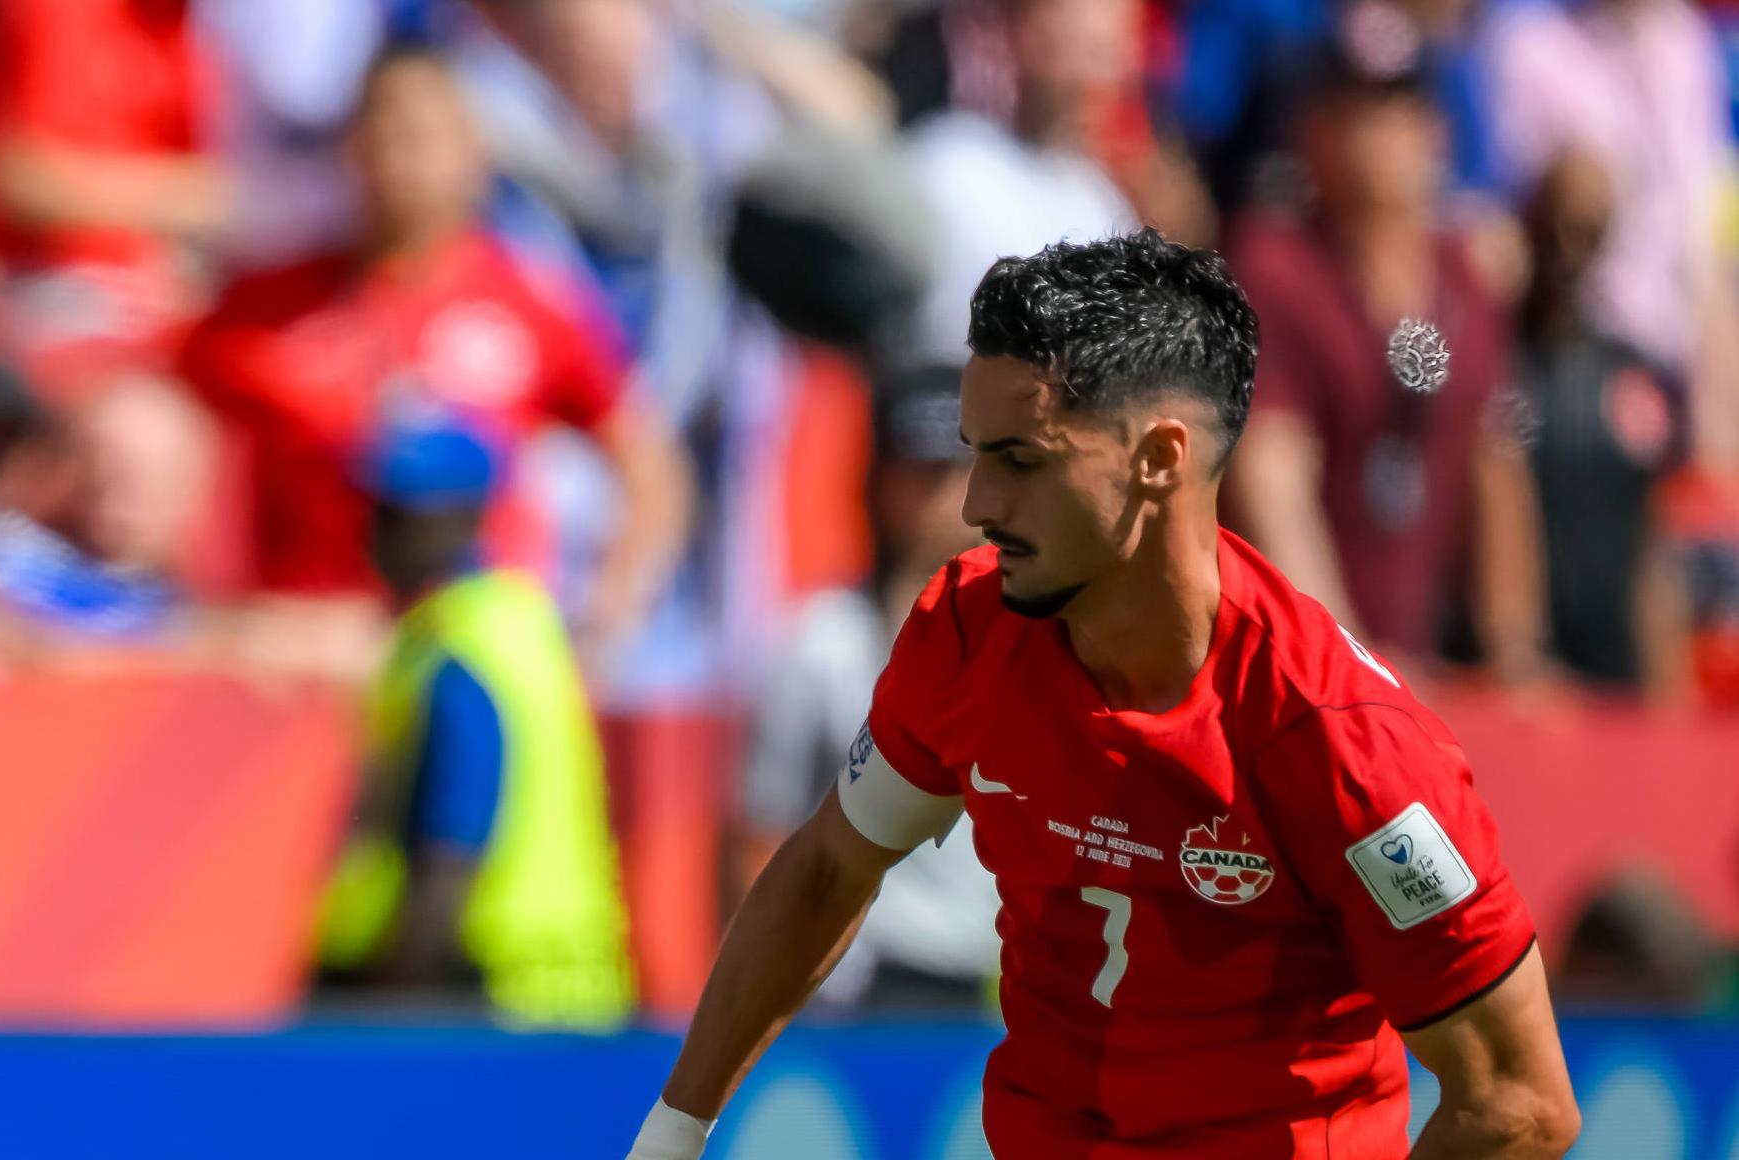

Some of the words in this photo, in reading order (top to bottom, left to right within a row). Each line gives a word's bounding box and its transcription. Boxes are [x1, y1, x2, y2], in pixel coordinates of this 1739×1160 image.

[1090, 815, 1129, 834] CANADA
[1181, 849, 1271, 871] CANADA
[1402, 868, 1445, 901] PEACE
[1081, 886, 1132, 1009] 7
